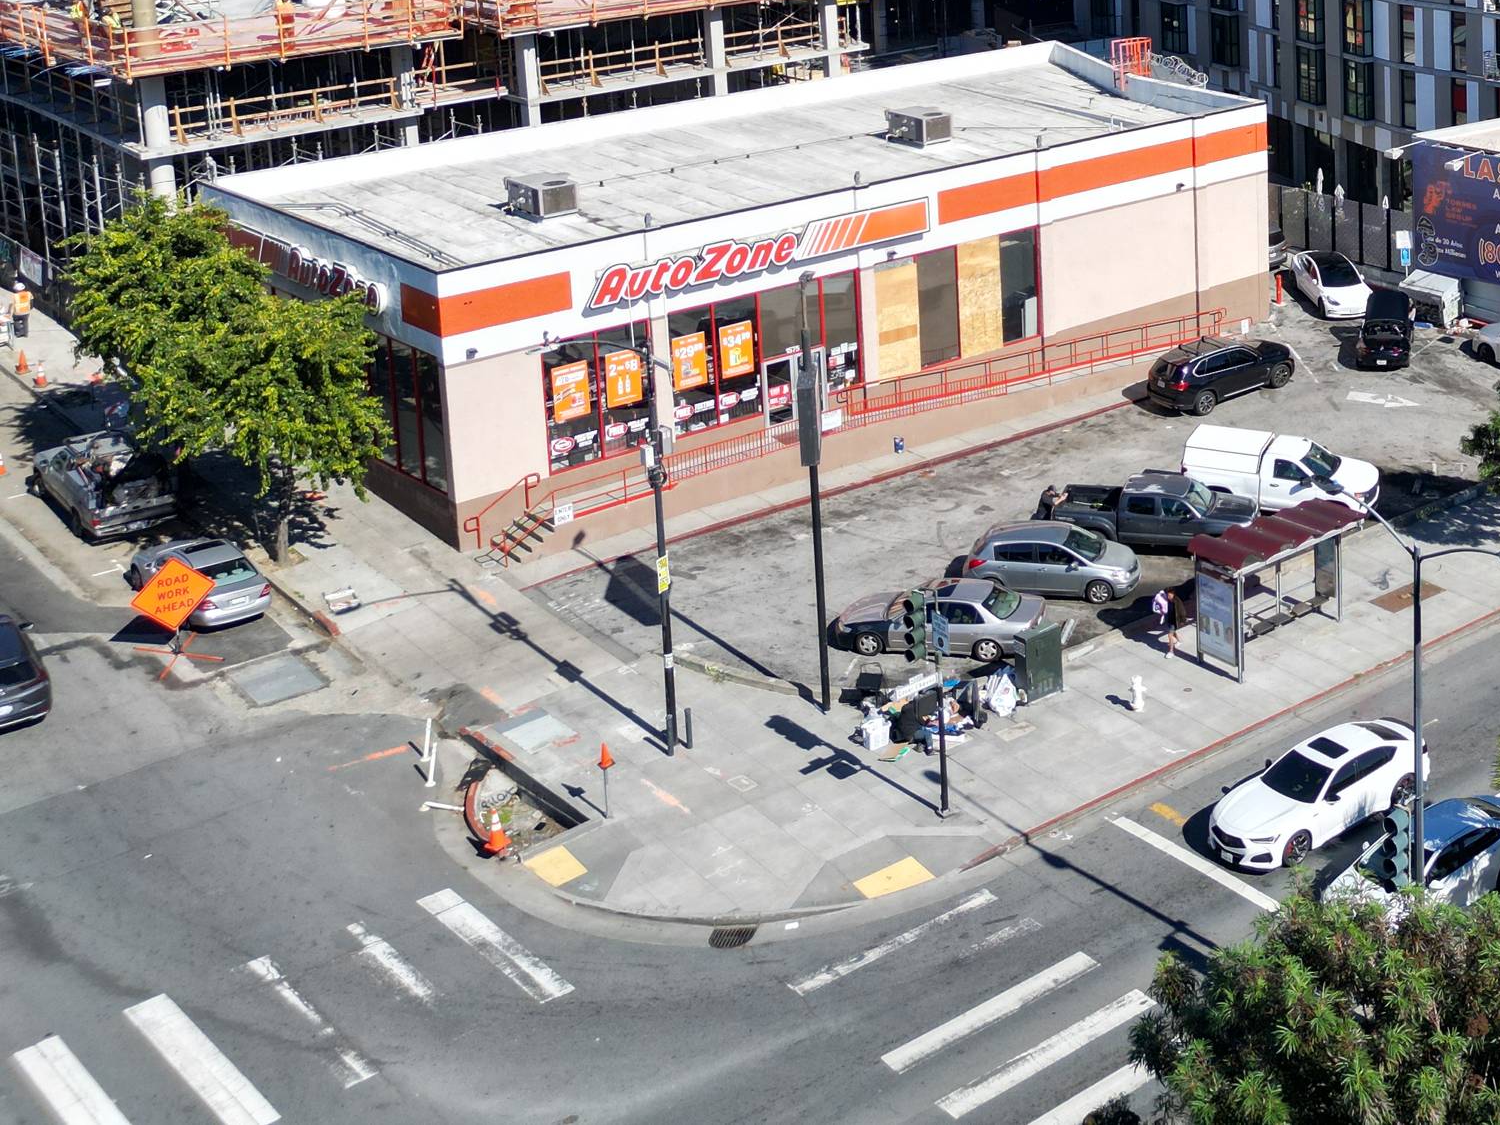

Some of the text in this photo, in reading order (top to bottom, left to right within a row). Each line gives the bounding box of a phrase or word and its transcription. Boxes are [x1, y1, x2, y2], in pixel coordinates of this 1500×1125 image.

[591, 233, 799, 308] AutoZone
[287, 246, 384, 316] AutoZone
[608, 364, 617, 377] 2
[555, 505, 571, 515] ENTER
[557, 514, 571, 523] ONLY
[156, 573, 190, 589] ROAD
[157, 586, 191, 602] WORK
[154, 598, 194, 615] AHEAD
